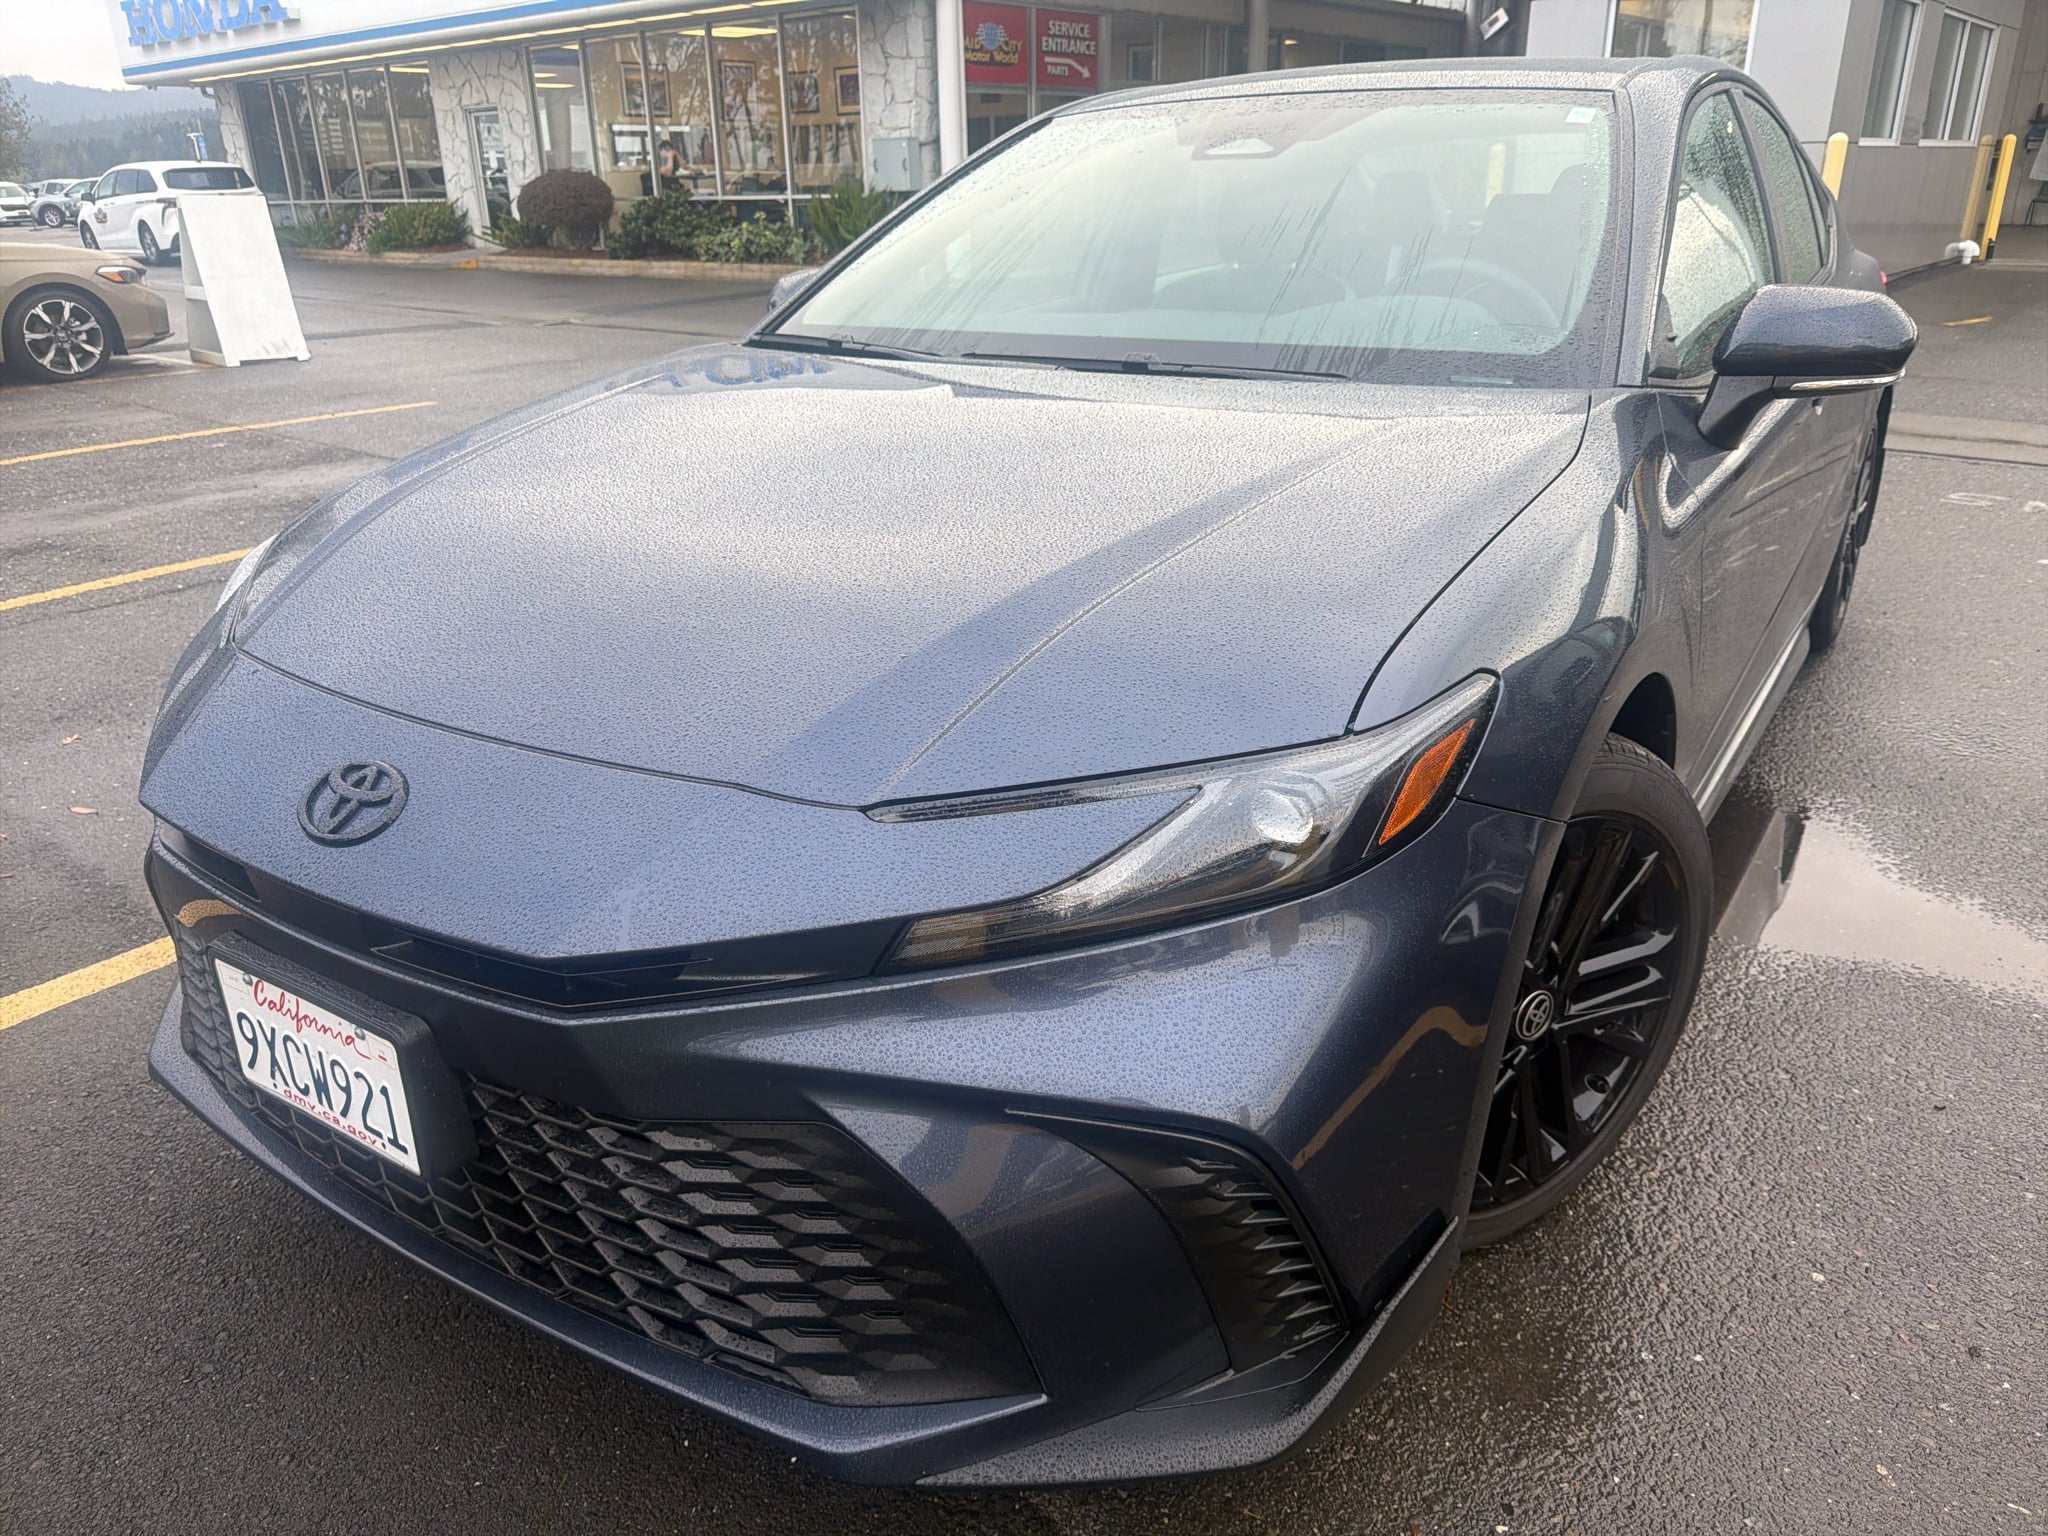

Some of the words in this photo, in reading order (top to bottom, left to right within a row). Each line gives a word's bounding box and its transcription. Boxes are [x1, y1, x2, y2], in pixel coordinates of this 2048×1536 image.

[121, 0, 288, 46] HONDA
[1047, 20, 1091, 38] SERVICE
[992, 50, 1019, 64] World
[1041, 36, 1097, 56] ENTRANCE
[1046, 64, 1070, 77] PARTS
[253, 978, 372, 1060] California
[236, 1011, 408, 1155] 9XCW921
[283, 1088, 378, 1146] dmv.ca.gov
